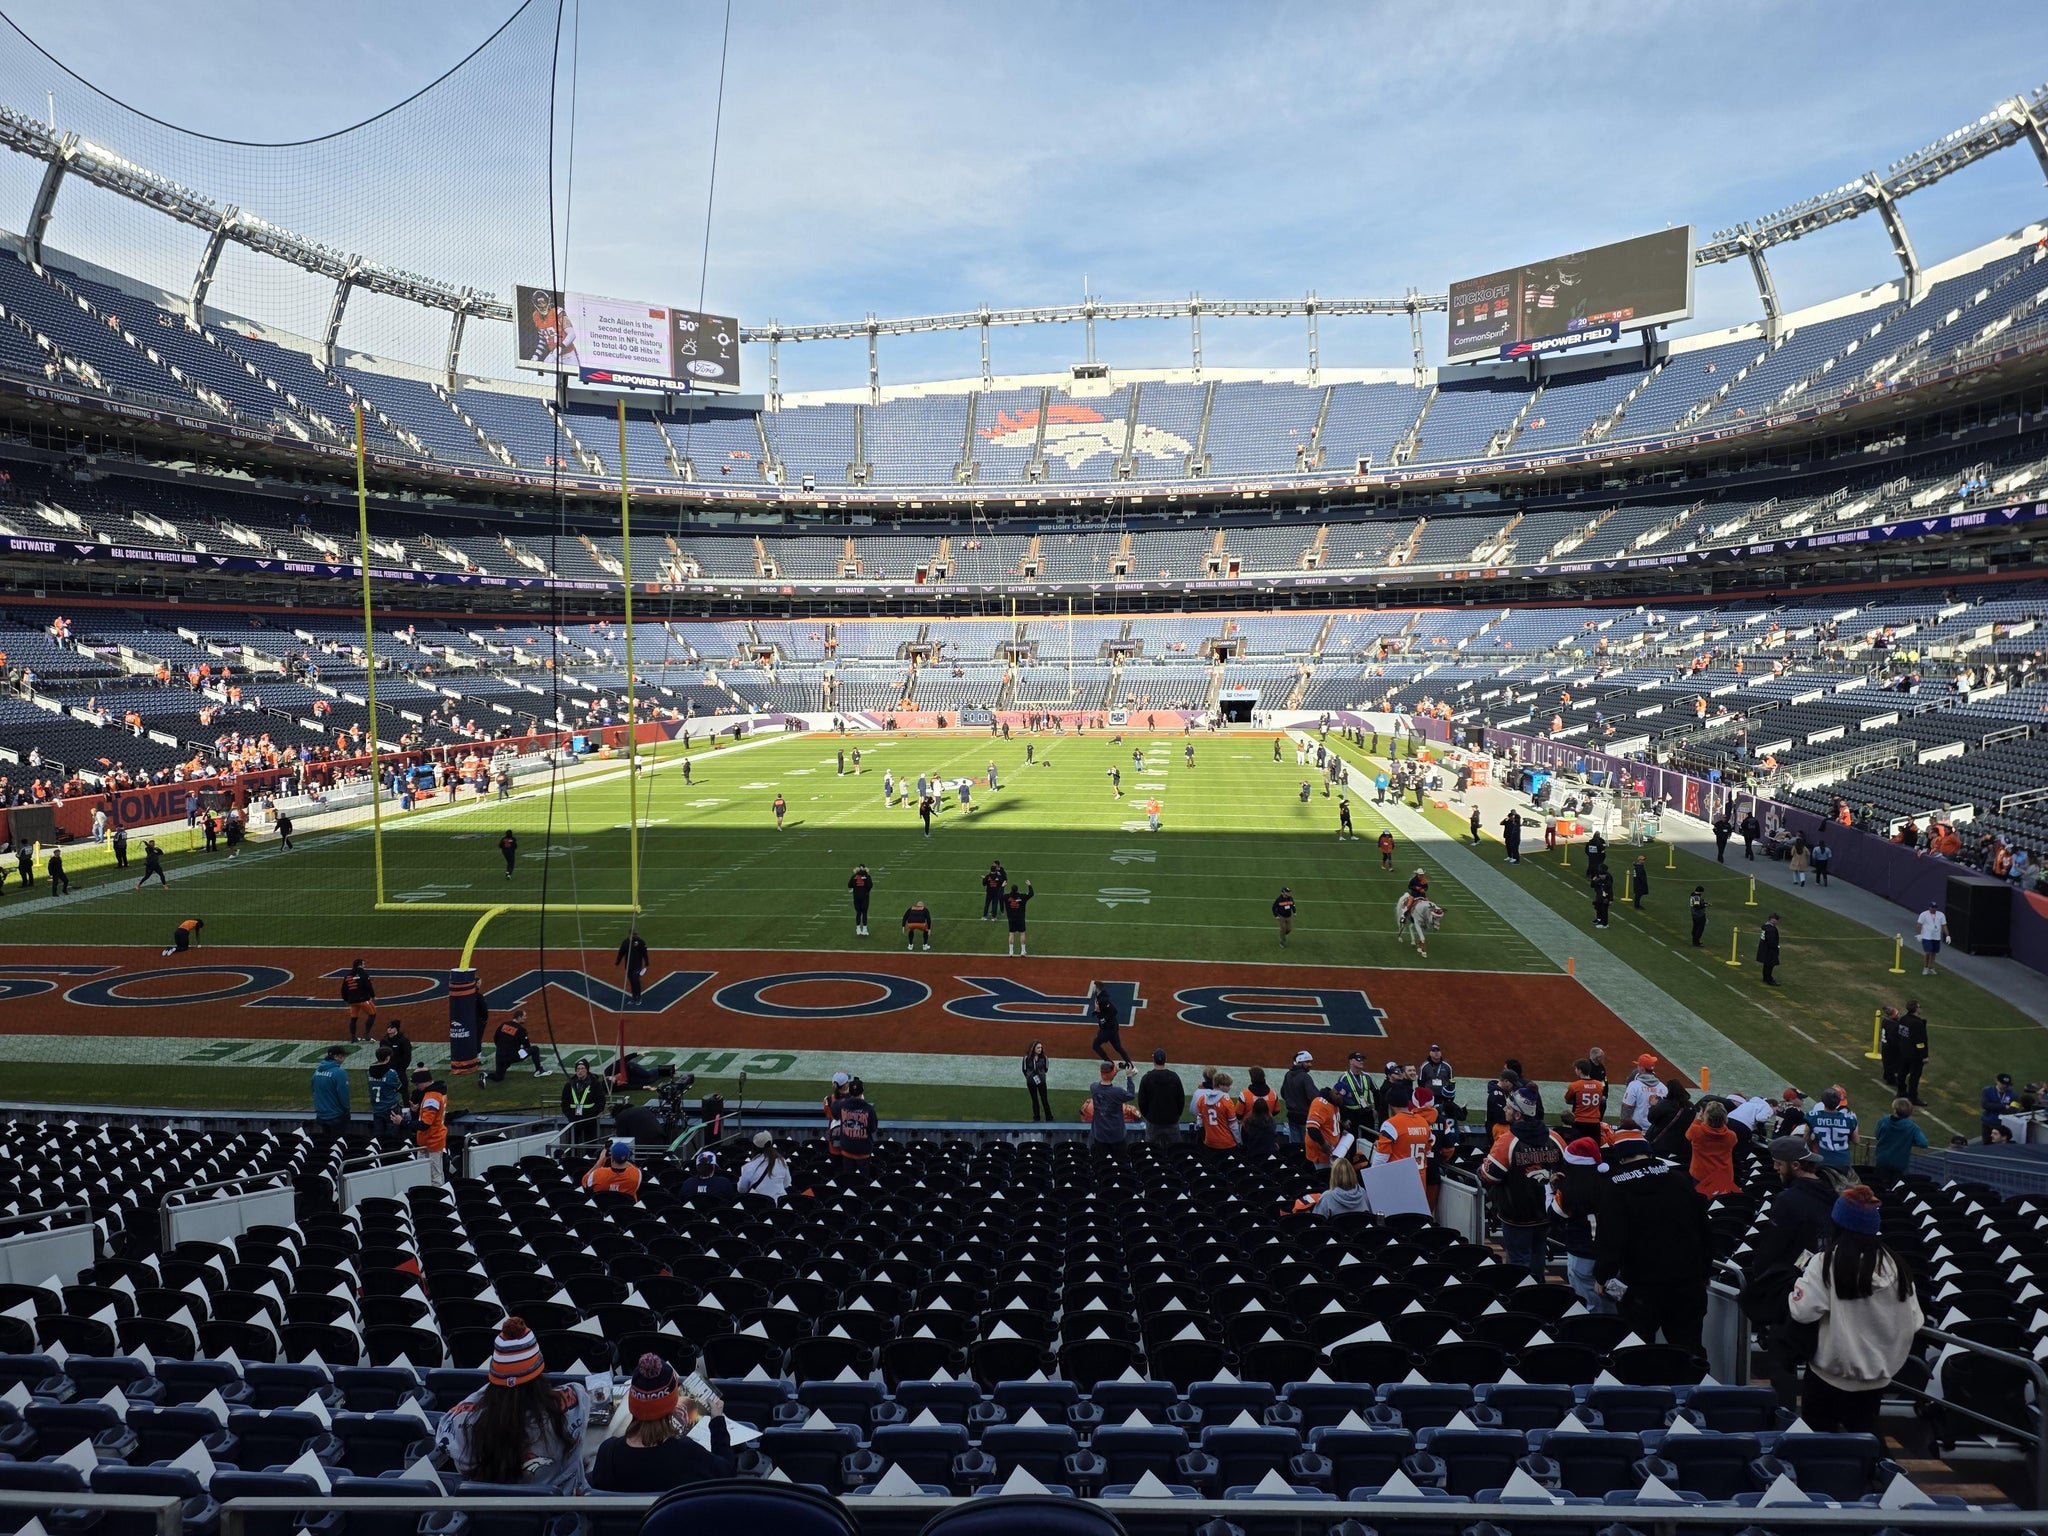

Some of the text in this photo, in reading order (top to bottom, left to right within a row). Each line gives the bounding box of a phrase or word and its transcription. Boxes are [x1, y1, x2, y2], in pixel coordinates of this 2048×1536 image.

[1454, 284, 1511, 308] KICKOFF
[1473, 303, 1489, 316] 54
[1494, 298, 1510, 310] 35
[599, 315, 615, 324] Zach
[616, 318, 634, 327] Allen
[642, 321, 653, 329] the
[1577, 318, 1588, 326] 20
[1612, 311, 1622, 319] 10
[598, 325, 654, 338] second defensive
[1454, 329, 1506, 345] CommonSpirit
[590, 331, 617, 341] lineman
[626, 336, 639, 344] NFL
[640, 339, 663, 349] history
[601, 342, 617, 350] total
[618, 343, 628, 351] 40
[1532, 328, 1613, 351] EMPOWER FIELD
[592, 350, 661, 364] consecutive seasons.
[612, 374, 686, 391] EMPOWER FIELD
[50, 391, 81, 405] THOMAS
[120, 405, 152, 419] MANNING
[1822, 402, 1841, 413] REEVES
[184, 418, 208, 430] MILLER
[1779, 414, 1798, 424] MINGO
[245, 430, 273, 441] FLETCHER
[1736, 427, 1752, 435] SMITH
[1677, 438, 1692, 446] DAVIS
[1600, 447, 1638, 457] ZIMMERMAN
[1478, 465, 1506, 473] JACKSON
[1951, 513, 1987, 528] CUTWATER
[10, 539, 57, 553] CUTWATER
[1750, 544, 1775, 554] CUTWATER
[111, 548, 198, 563] REAL COCKTAILS. PERFECTLY MIXED.
[284, 562, 315, 573] CUTWATER
[1560, 563, 1593, 572] CUTWATER
[480, 577, 507, 586] CUTWATER
[1531, 742, 1553, 767] MILE
[1584, 754, 1609, 774] CITY
[98, 788, 186, 828] HOME
[372, 1086, 381, 1103] 7
[1582, 1093, 1600, 1106] 58
[1208, 1109, 1218, 1126] 2
[1813, 1126, 1850, 1151] 35
[1409, 1143, 1426, 1169] 15
